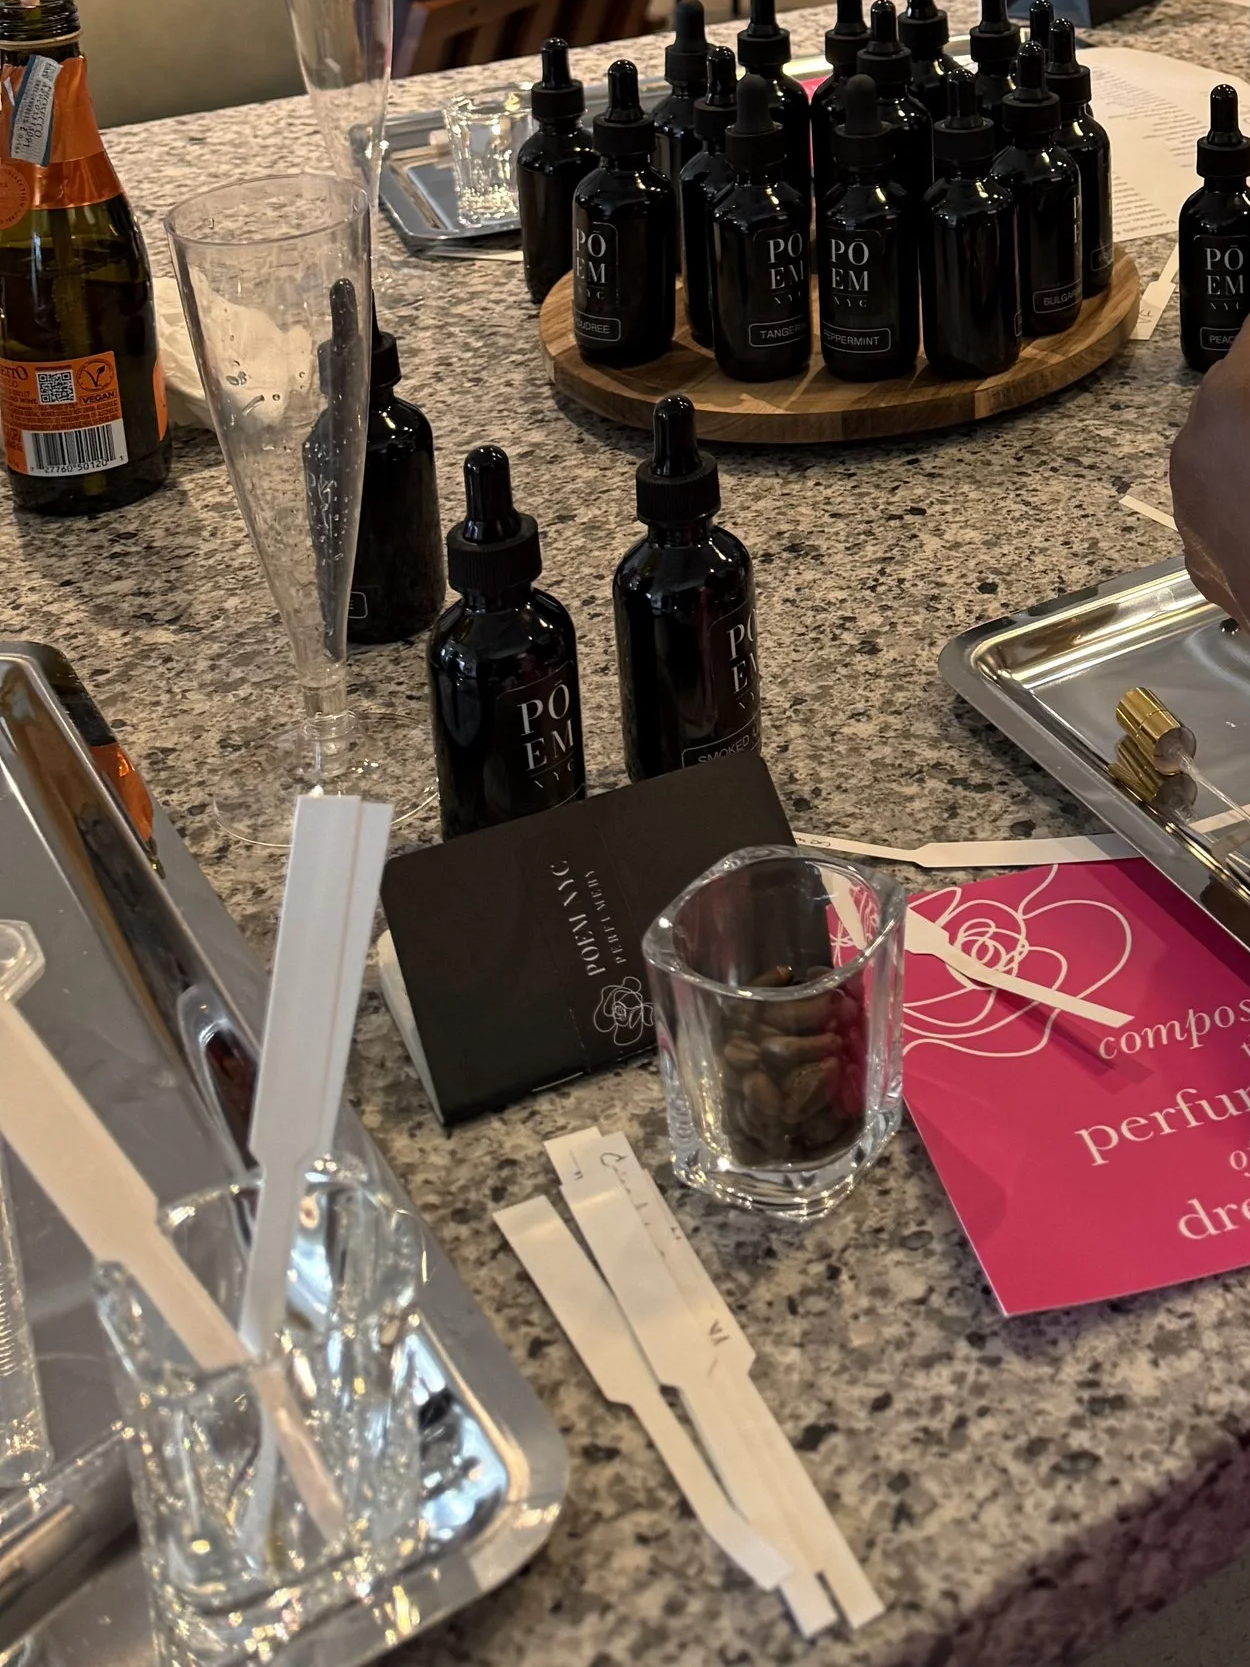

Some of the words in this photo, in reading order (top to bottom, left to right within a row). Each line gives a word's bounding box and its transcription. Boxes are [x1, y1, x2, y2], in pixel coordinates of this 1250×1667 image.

[576, 256, 606, 283] EM
[830, 267, 869, 291] EM
[1205, 274, 1245, 295] EM
[760, 323, 804, 339] TANGER
[1208, 334, 1236, 346] PEAC
[82, 391, 115, 404] VEGAN
[45, 465, 73, 474] 27760
[77, 458, 108, 471] 50120
[522, 718, 574, 771] EM
[550, 860, 579, 907] NYC
[569, 913, 606, 976] POEM
